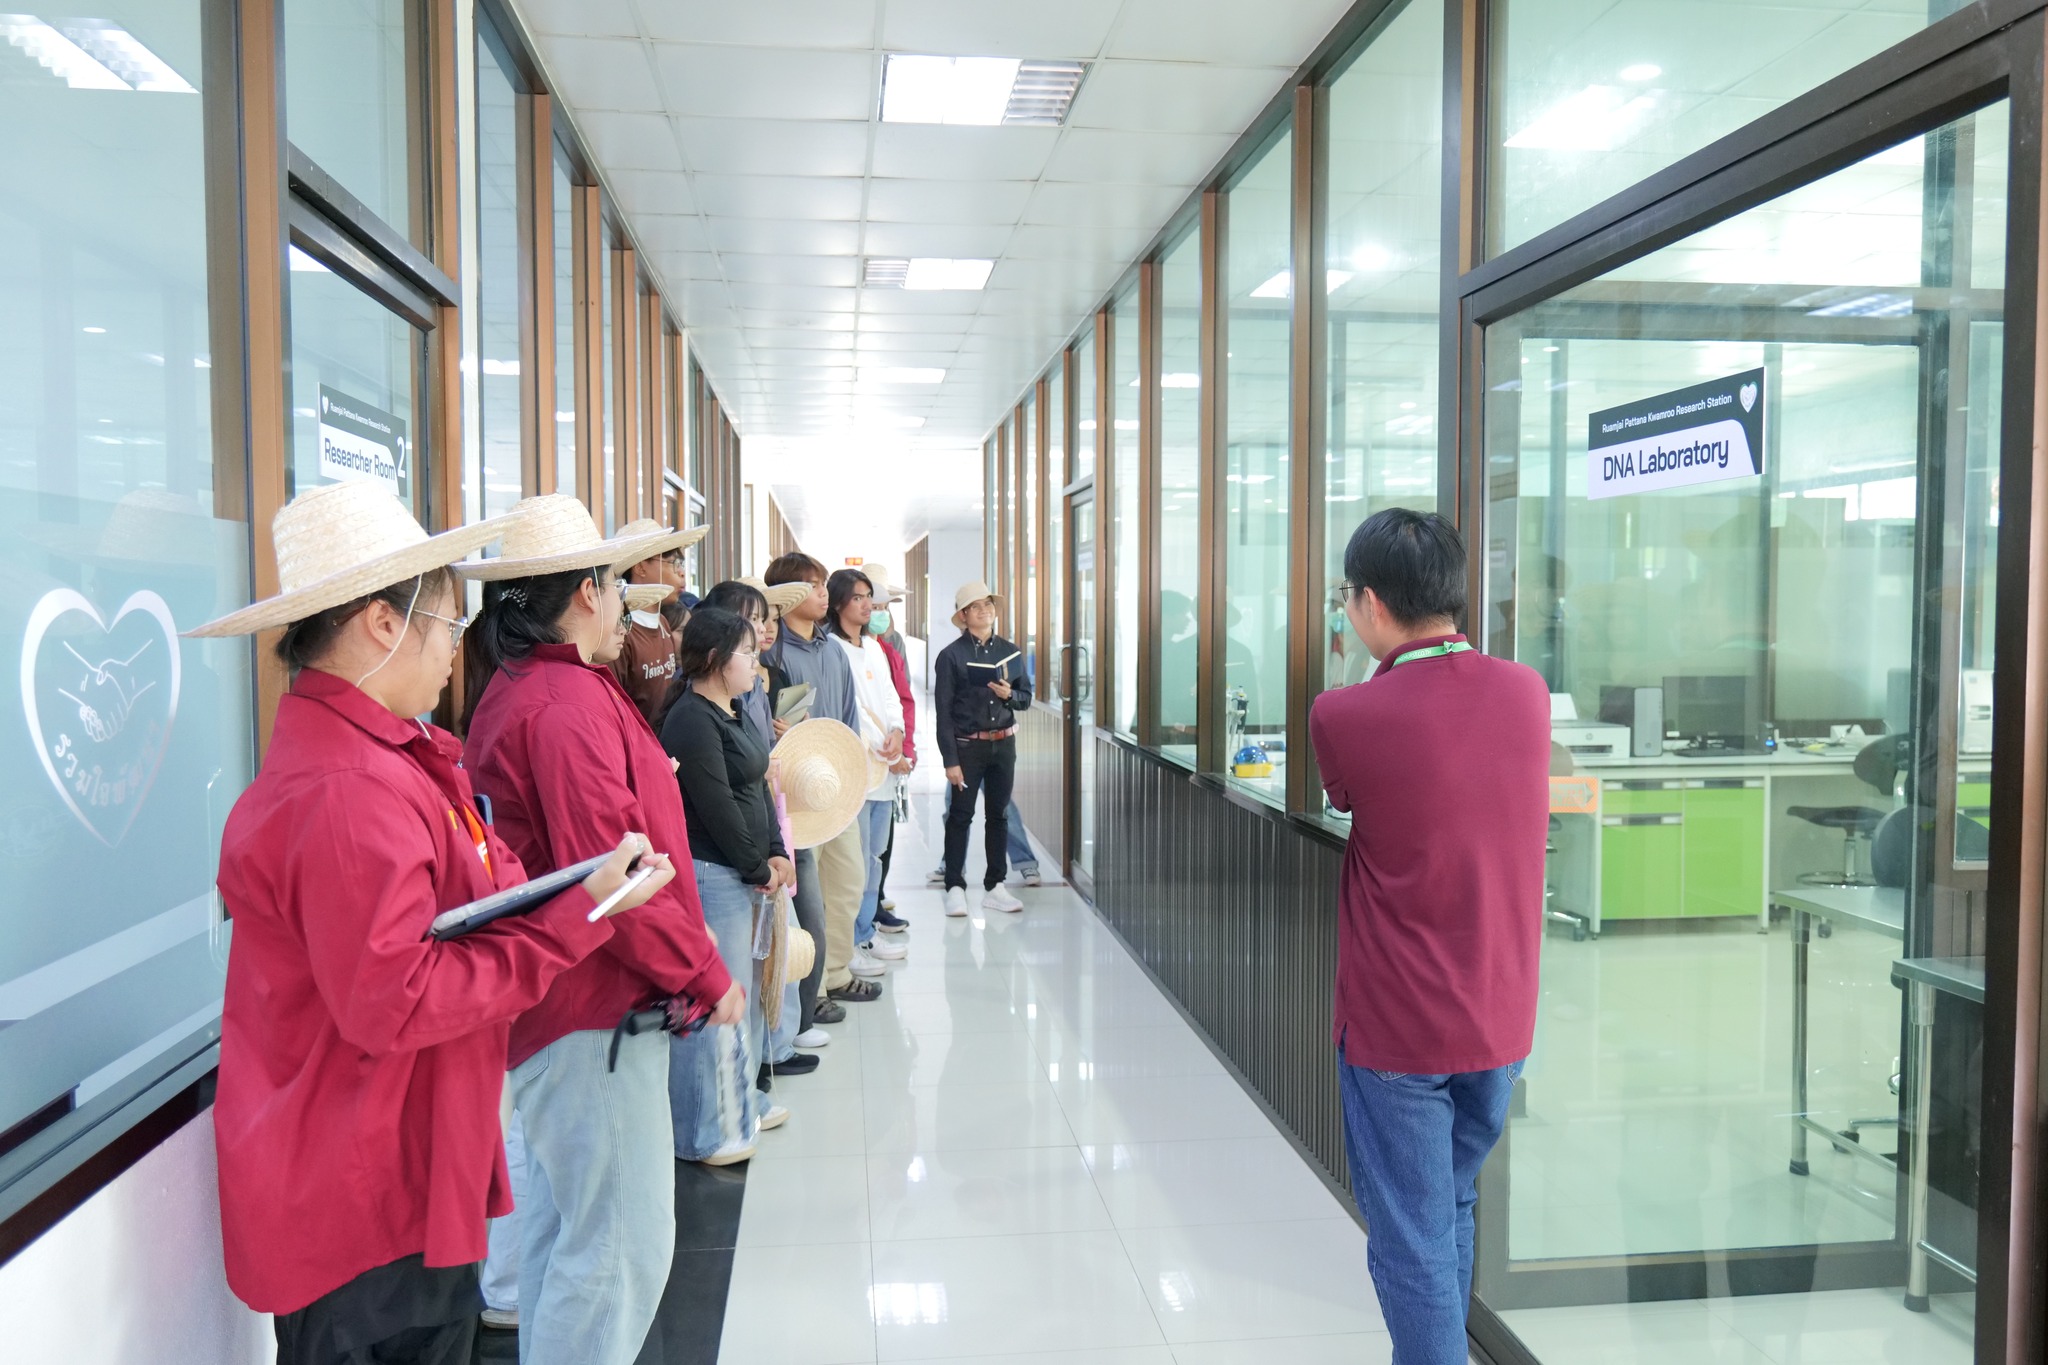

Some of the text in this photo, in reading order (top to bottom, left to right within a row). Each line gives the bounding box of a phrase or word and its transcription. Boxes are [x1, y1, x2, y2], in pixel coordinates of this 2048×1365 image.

[1625, 416, 1647, 428] Pattana
[1648, 409, 1675, 422] Kwamroo
[1676, 399, 1706, 416] Research
[1707, 394, 1733, 409] Station
[324, 437, 396, 481] Researcher Room
[396, 436, 406, 479] 2
[1603, 440, 1729, 481] DNA Laboratory
